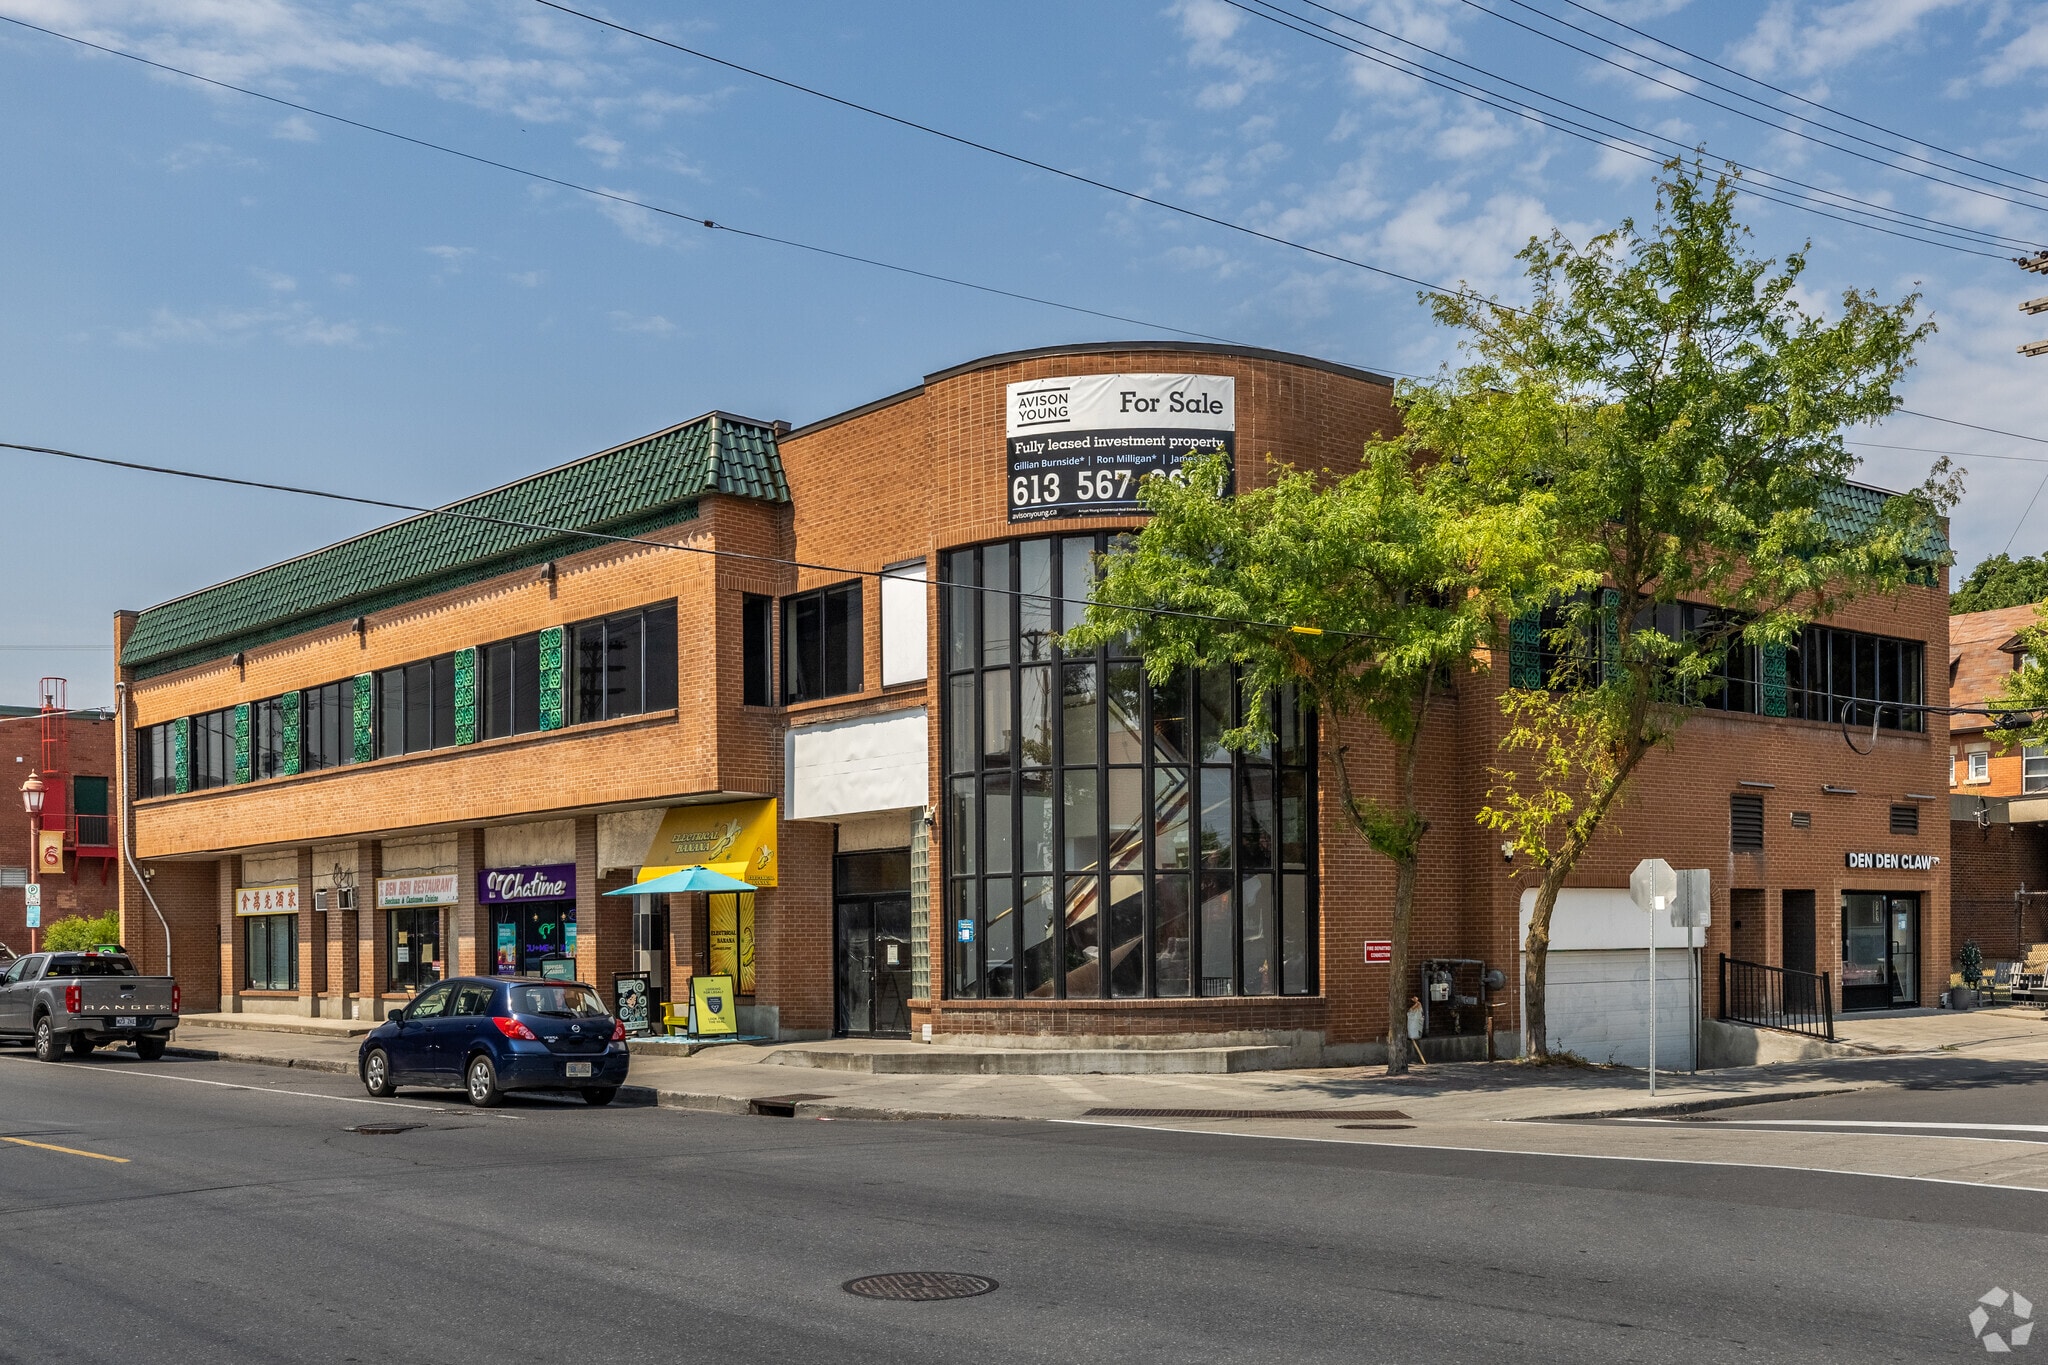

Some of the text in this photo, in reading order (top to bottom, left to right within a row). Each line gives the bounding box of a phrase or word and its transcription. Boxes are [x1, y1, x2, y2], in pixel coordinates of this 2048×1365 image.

[1018, 393, 1069, 409] AVISON
[1120, 391, 1224, 415] For Sale
[1018, 406, 1069, 421] YOUNG
[1015, 435, 1225, 455] Fully leased investment property
[1014, 460, 1039, 470] Gillian
[1096, 455, 1114, 464] Ron
[1013, 473, 1060, 506] 613
[1077, 469, 1132, 500] 567
[1012, 509, 1057, 520] avisonyoung.ca
[671, 831, 720, 843] ELECTRICAL
[675, 842, 711, 854] BANANA
[1849, 852, 1931, 870] DEN DEN CLAW
[385, 881, 397, 896] BEN
[399, 880, 411, 895] BEN
[413, 877, 453, 894] RESTAURANT
[501, 871, 566, 900] Chatime
